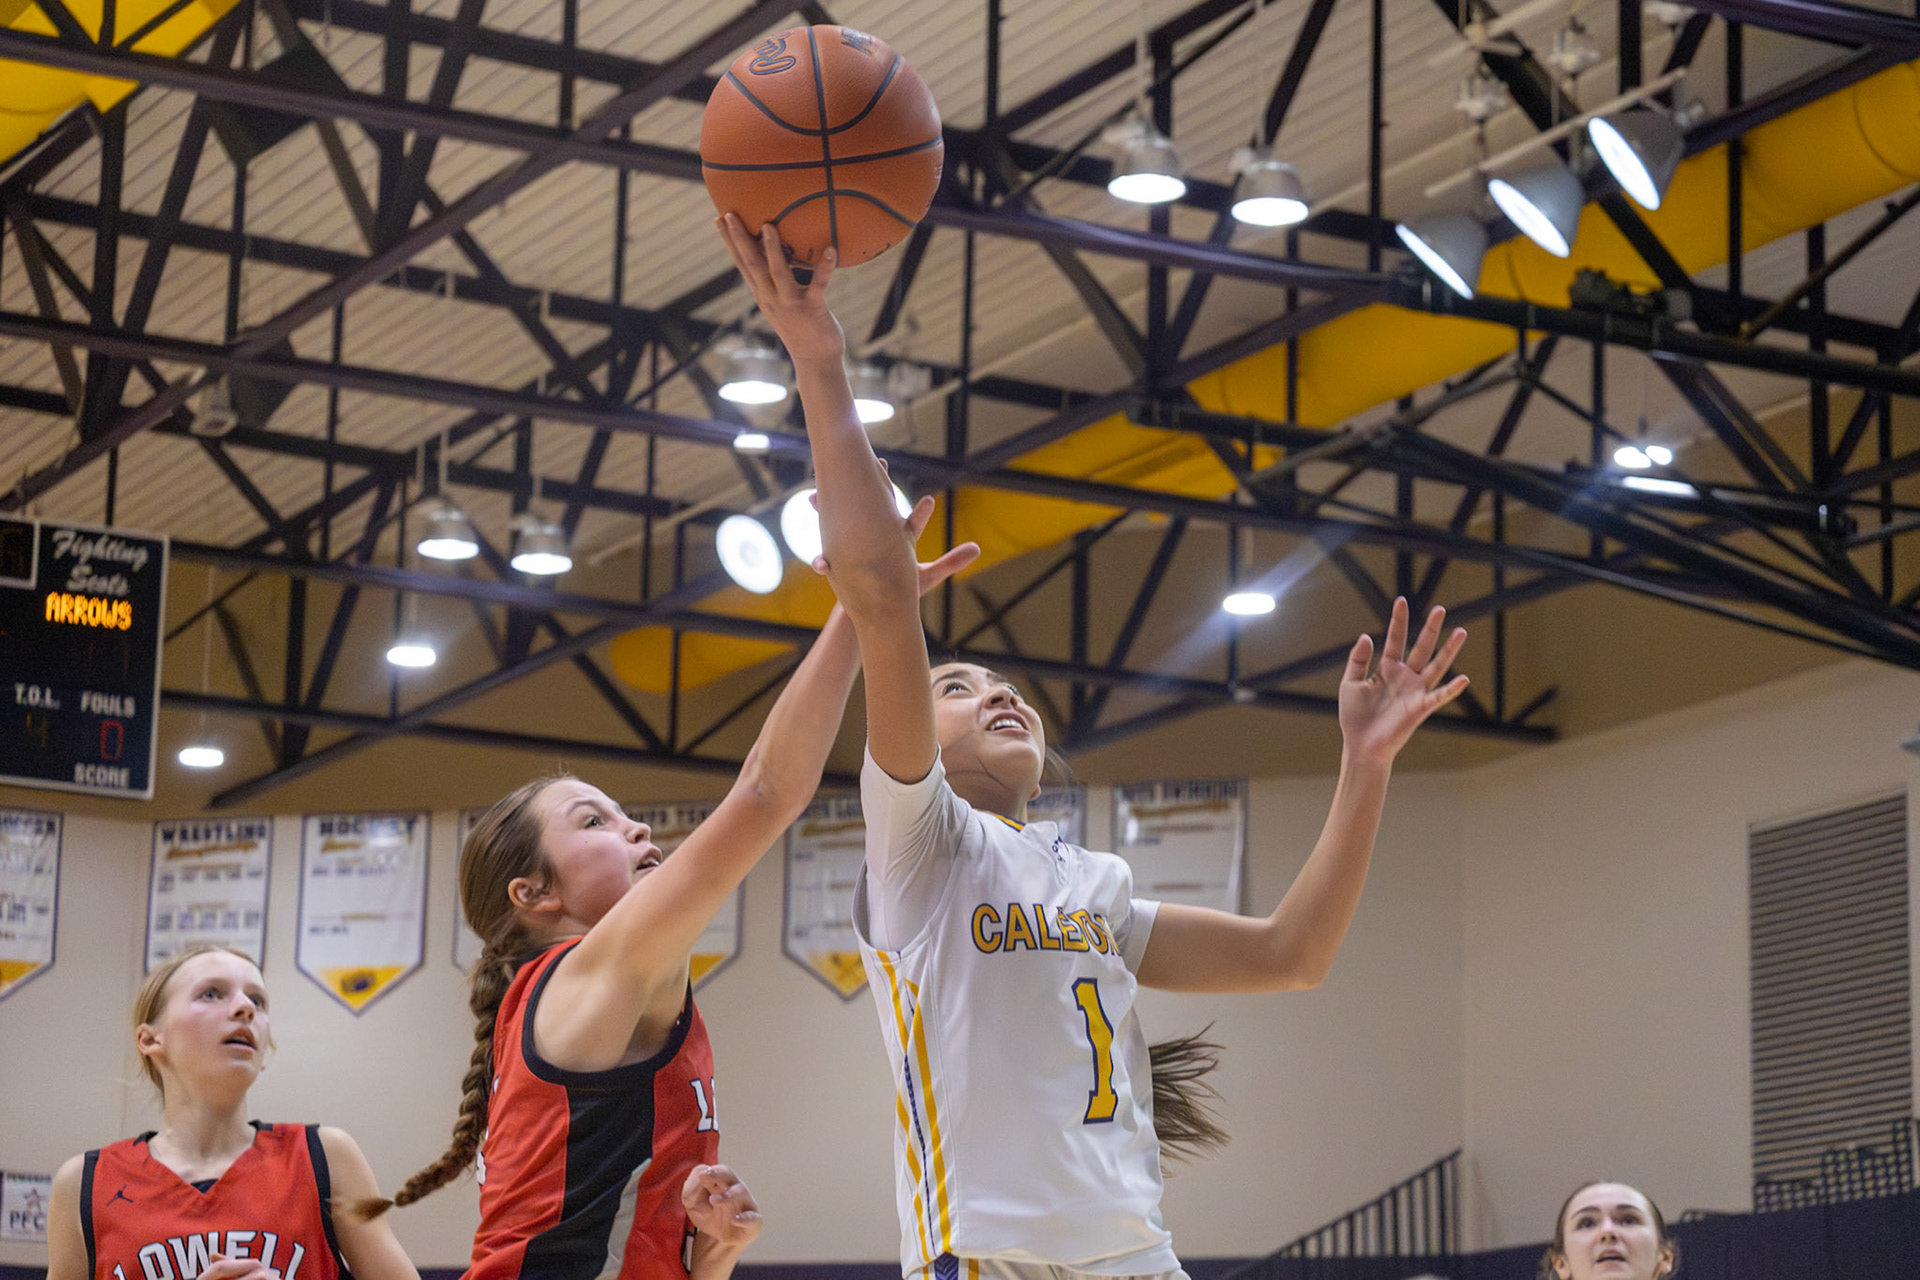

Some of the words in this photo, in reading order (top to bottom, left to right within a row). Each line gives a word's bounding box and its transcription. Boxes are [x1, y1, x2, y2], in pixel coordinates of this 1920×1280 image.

[52, 530, 149, 572] Fighting
[45, 591, 133, 631] ARROWS
[15, 683, 61, 710] T.O.L.
[80, 690, 136, 719] FOULS
[100, 719, 124, 760] 0
[74, 763, 131, 788] SCORE
[161, 823, 266, 844] WRESTLING
[1071, 978, 1118, 1124] 1
